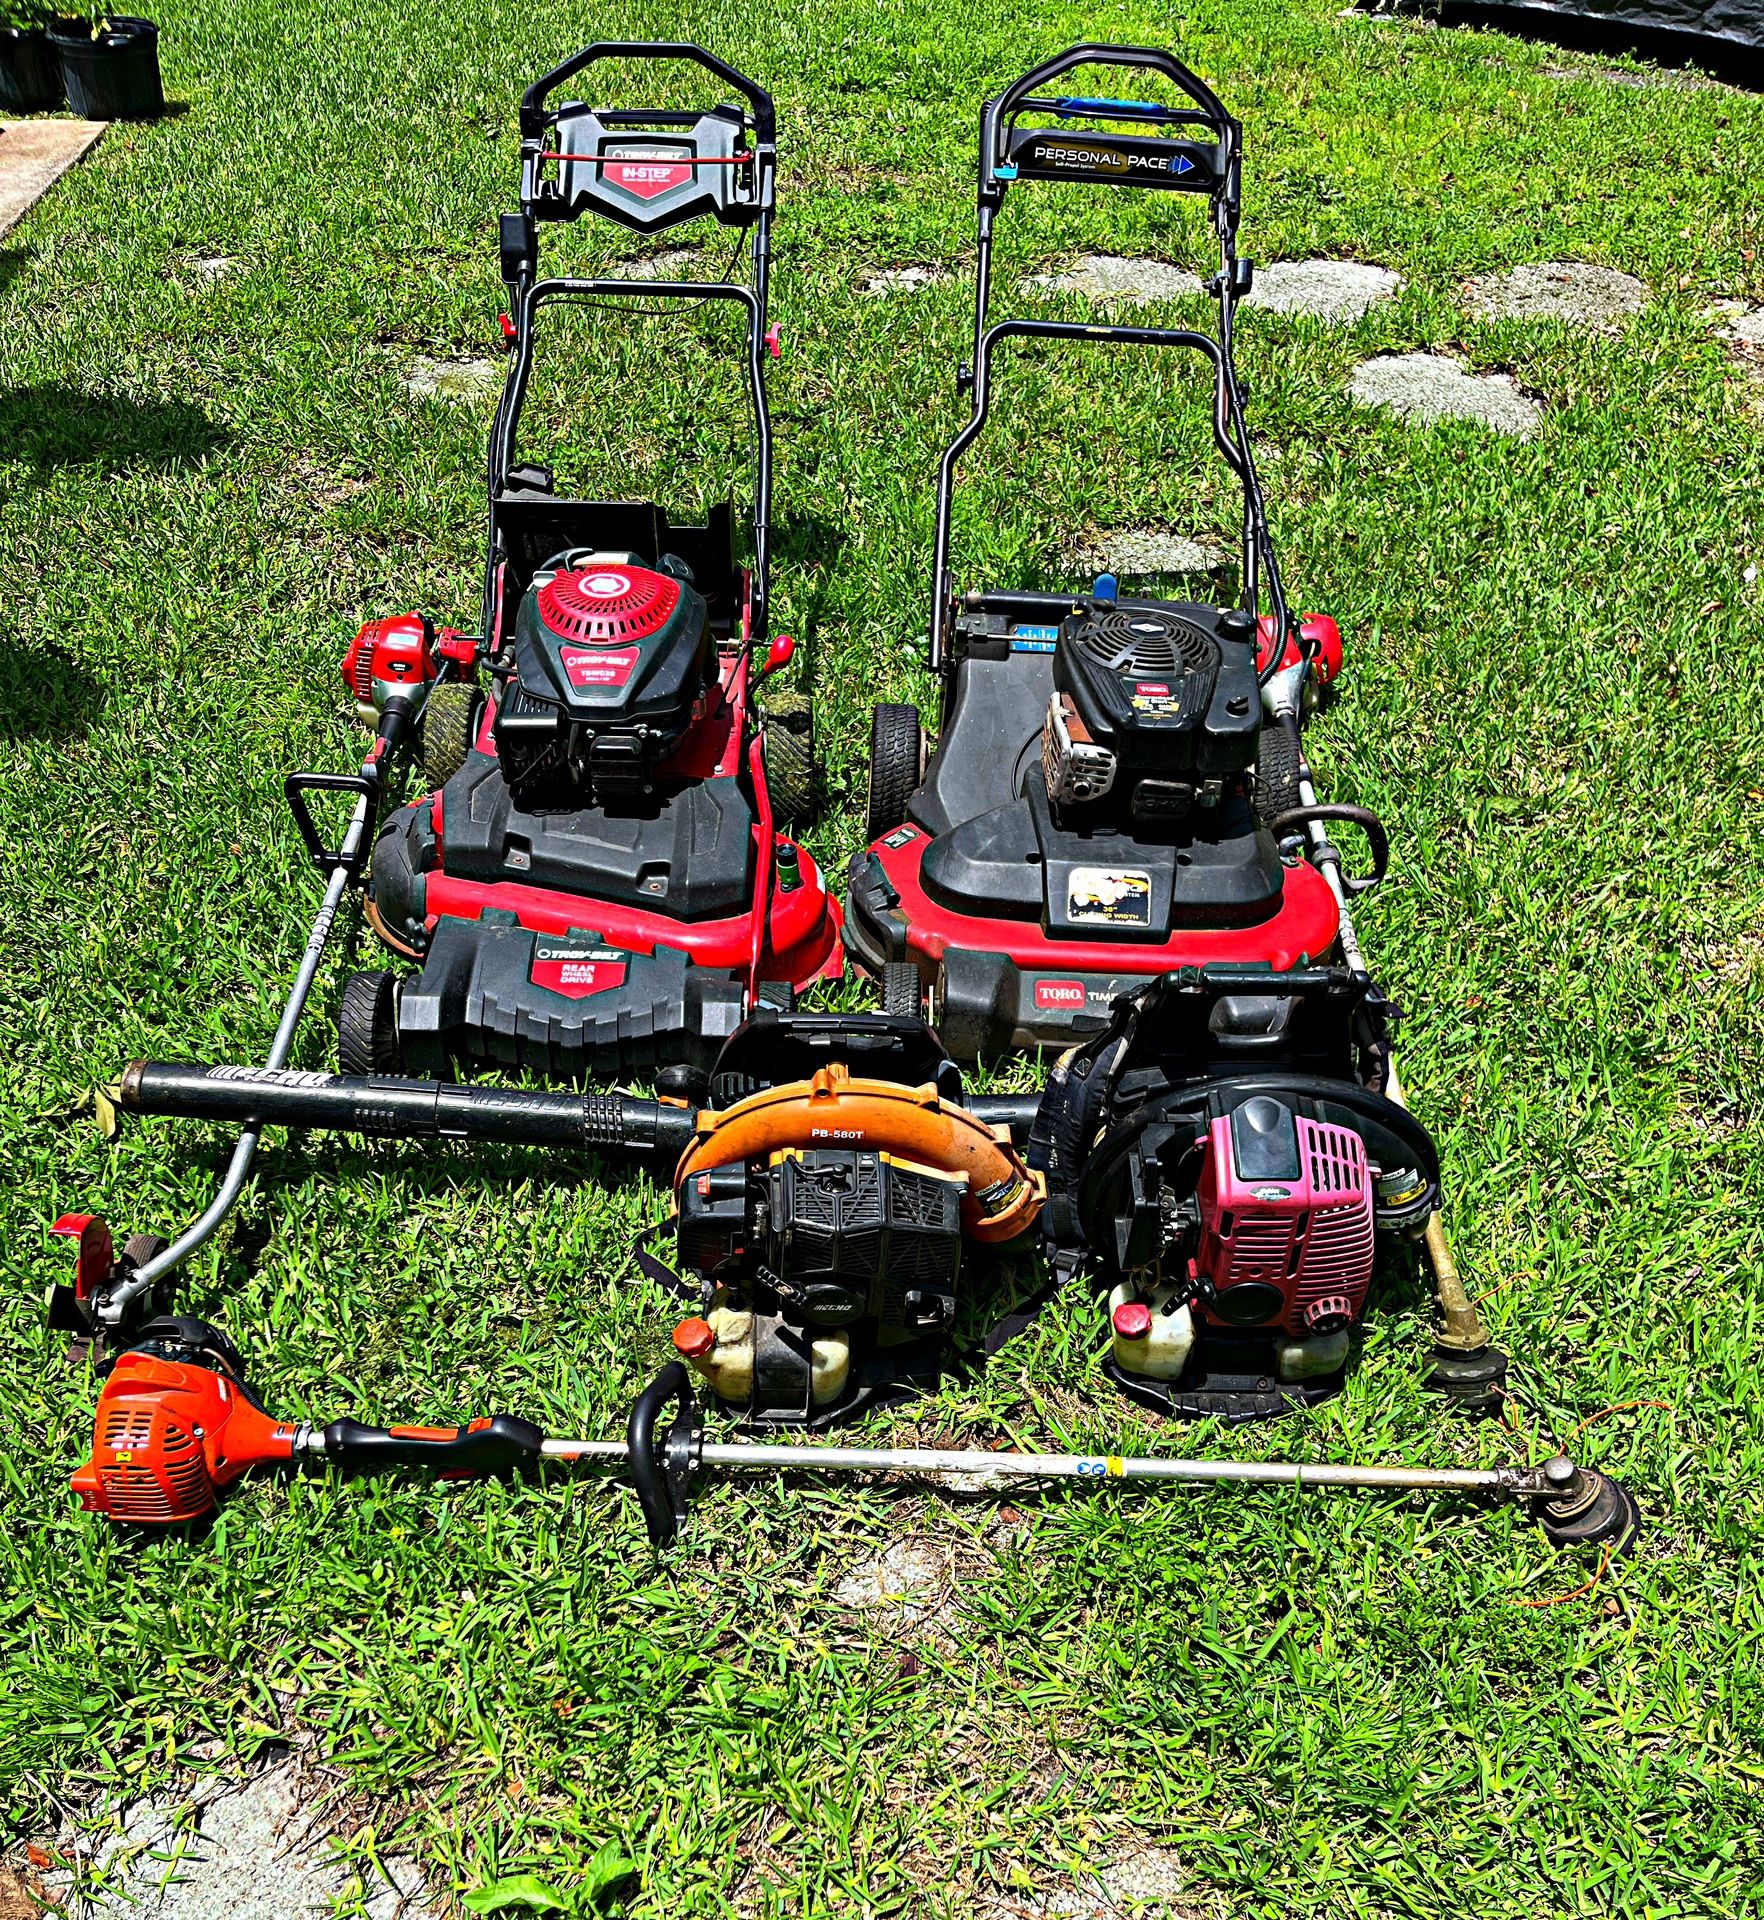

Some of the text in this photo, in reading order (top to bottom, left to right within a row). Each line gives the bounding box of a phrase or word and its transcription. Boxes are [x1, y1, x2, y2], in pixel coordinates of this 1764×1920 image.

[1034, 147, 1168, 170] PERSONAL PACE
[622, 167, 671, 178] IN-STEP
[551, 950, 625, 960] TROY-BILT
[562, 964, 595, 972] REAR
[560, 976, 594, 984] DRIVE
[1040, 987, 1083, 1002] TORO
[811, 1128, 864, 1139] PB-580T
